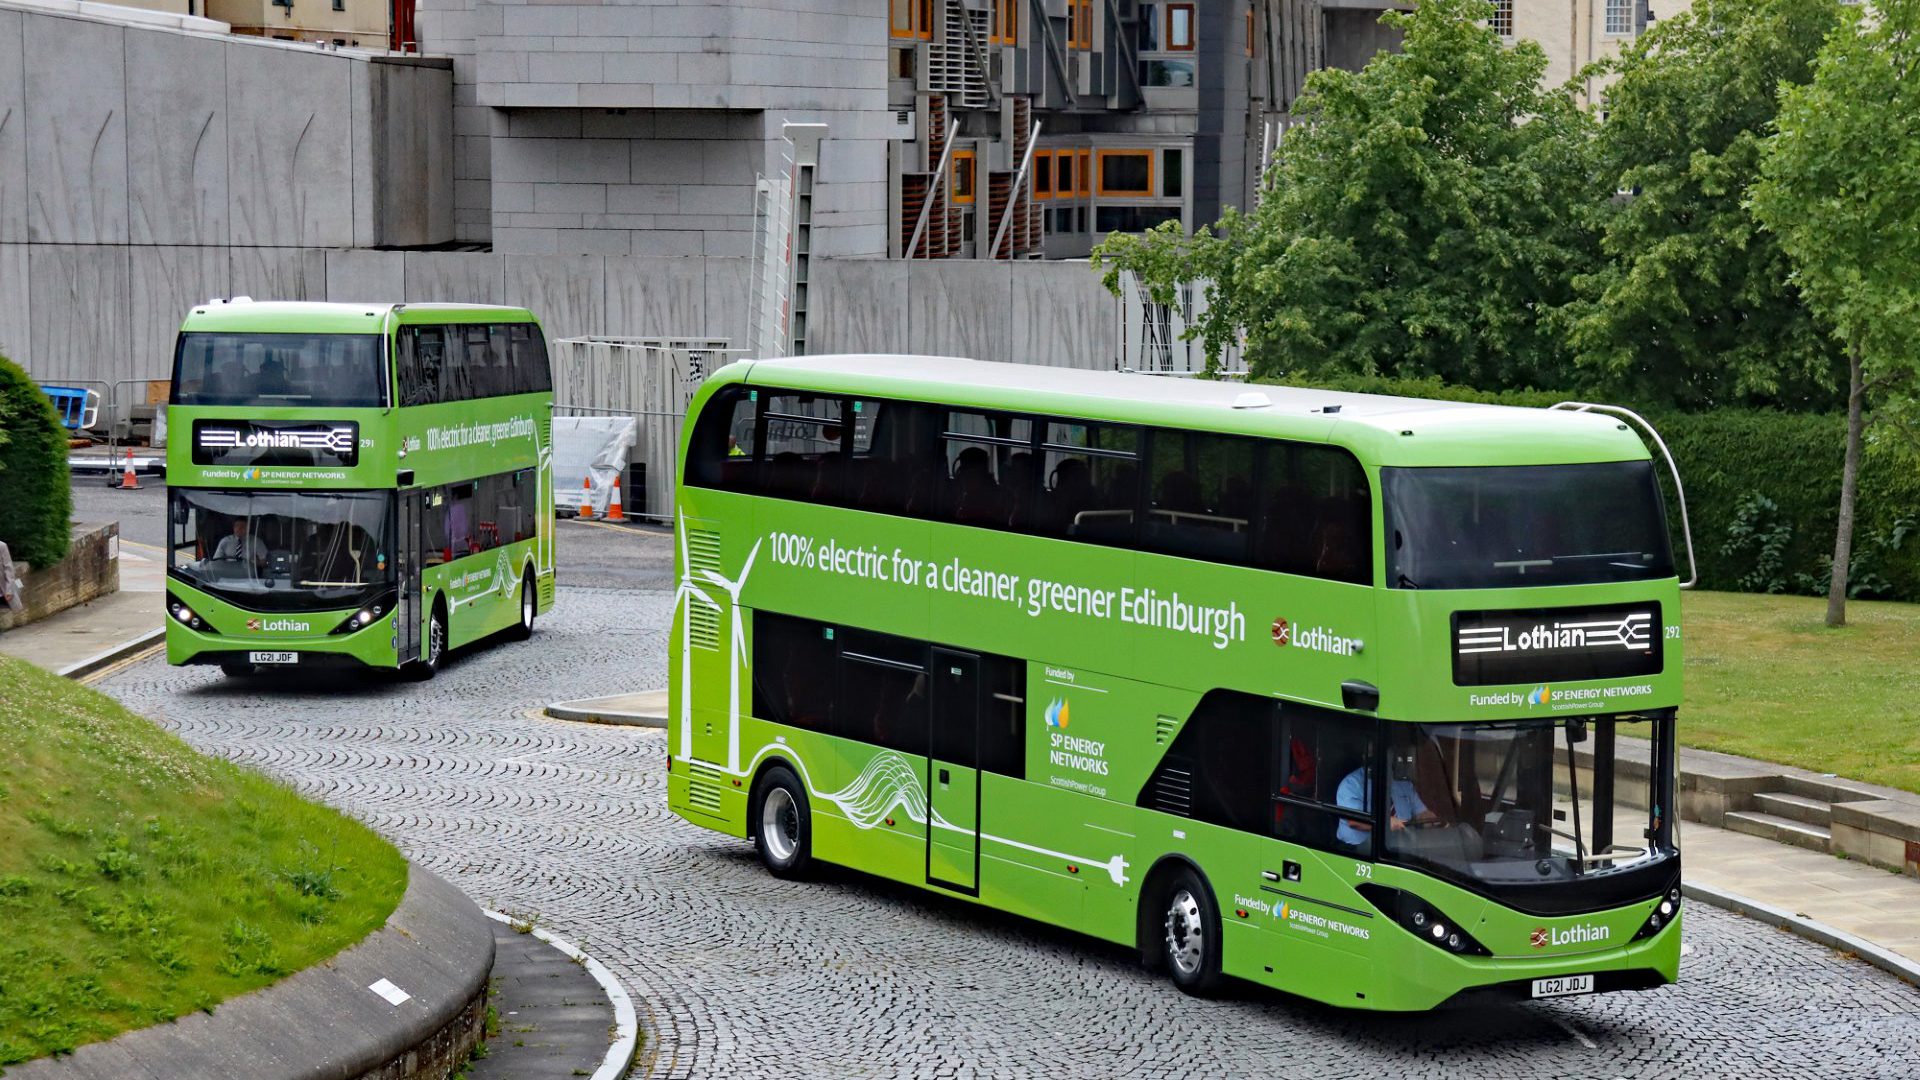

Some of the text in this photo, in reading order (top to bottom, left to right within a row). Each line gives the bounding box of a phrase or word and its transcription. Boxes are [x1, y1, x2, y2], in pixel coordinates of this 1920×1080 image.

[235, 430, 301, 448] Lothian
[426, 427, 441, 451] 100%
[441, 424, 460, 450] electric
[461, 423, 469, 446] for
[492, 423, 511, 447] greener
[511, 413, 534, 441] Edinburgh
[360, 439, 374, 449] 291
[202, 470, 229, 479] Funded
[230, 470, 240, 480] by
[261, 471, 270, 479] SP
[270, 471, 300, 479] ENERGY
[769, 531, 1246, 650] 100% electric for a cleaner, greener Edinburgh
[263, 619, 310, 632] Lothian
[1665, 625, 1681, 639] 292
[1292, 622, 1353, 657] Lothian
[1503, 622, 1586, 651] Lothian
[254, 653, 293, 662] LG21 JDF
[1045, 666, 1075, 683] Funded by
[1470, 684, 1652, 706] Funded by SP ENERGY NETWORKS
[1551, 701, 1604, 711] ScottishPower Group
[1050, 732, 1105, 757] SP ENERGY
[1050, 750, 1109, 776] NETWORKS
[1050, 776, 1106, 797] ScottishPower Group
[1355, 863, 1372, 879] 292
[1234, 894, 1370, 940] Funded by SP ENERGY NETWORKS
[1551, 923, 1610, 946] Lothian
[1539, 977, 1587, 994] LG21 JDJ
